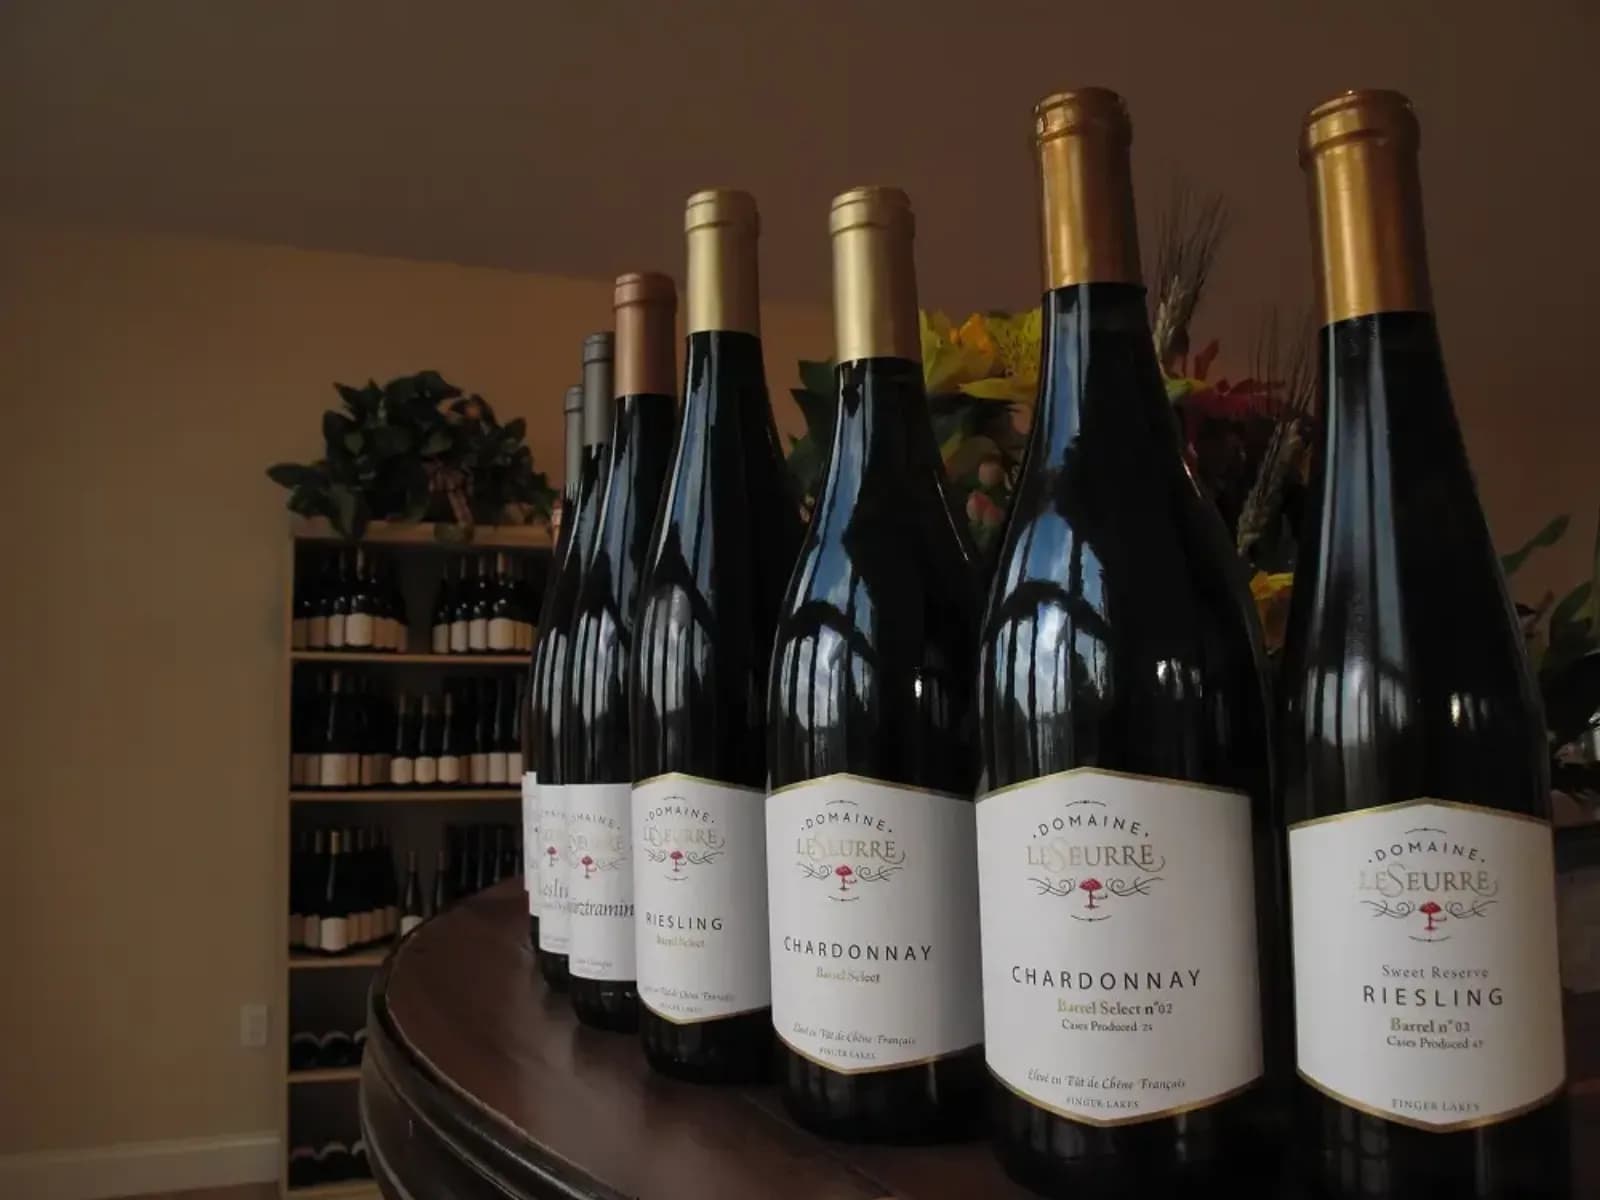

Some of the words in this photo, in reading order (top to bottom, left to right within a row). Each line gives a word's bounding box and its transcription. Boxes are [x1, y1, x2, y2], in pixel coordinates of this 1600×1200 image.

[649, 805, 710, 823] DOMAINE
[806, 811, 886, 832] DOMAINE
[1038, 815, 1141, 835] DOMAINE
[1376, 841, 1478, 861] DOMAINE
[645, 911, 723, 931] RIESLING
[784, 936, 932, 961] CHARDONNAY
[1012, 965, 1200, 991] CHARDONNAY
[1382, 964, 1425, 979] Sweet
[1431, 965, 1489, 979] Reserve
[1363, 984, 1504, 1007] RIESLING
[1057, 998, 1097, 1015] Barrel
[1100, 1000, 1141, 1015] Select
[1091, 1020, 1138, 1032] Produced
[1390, 1017, 1434, 1033] Barrel
[1420, 1036, 1469, 1050] Produced
